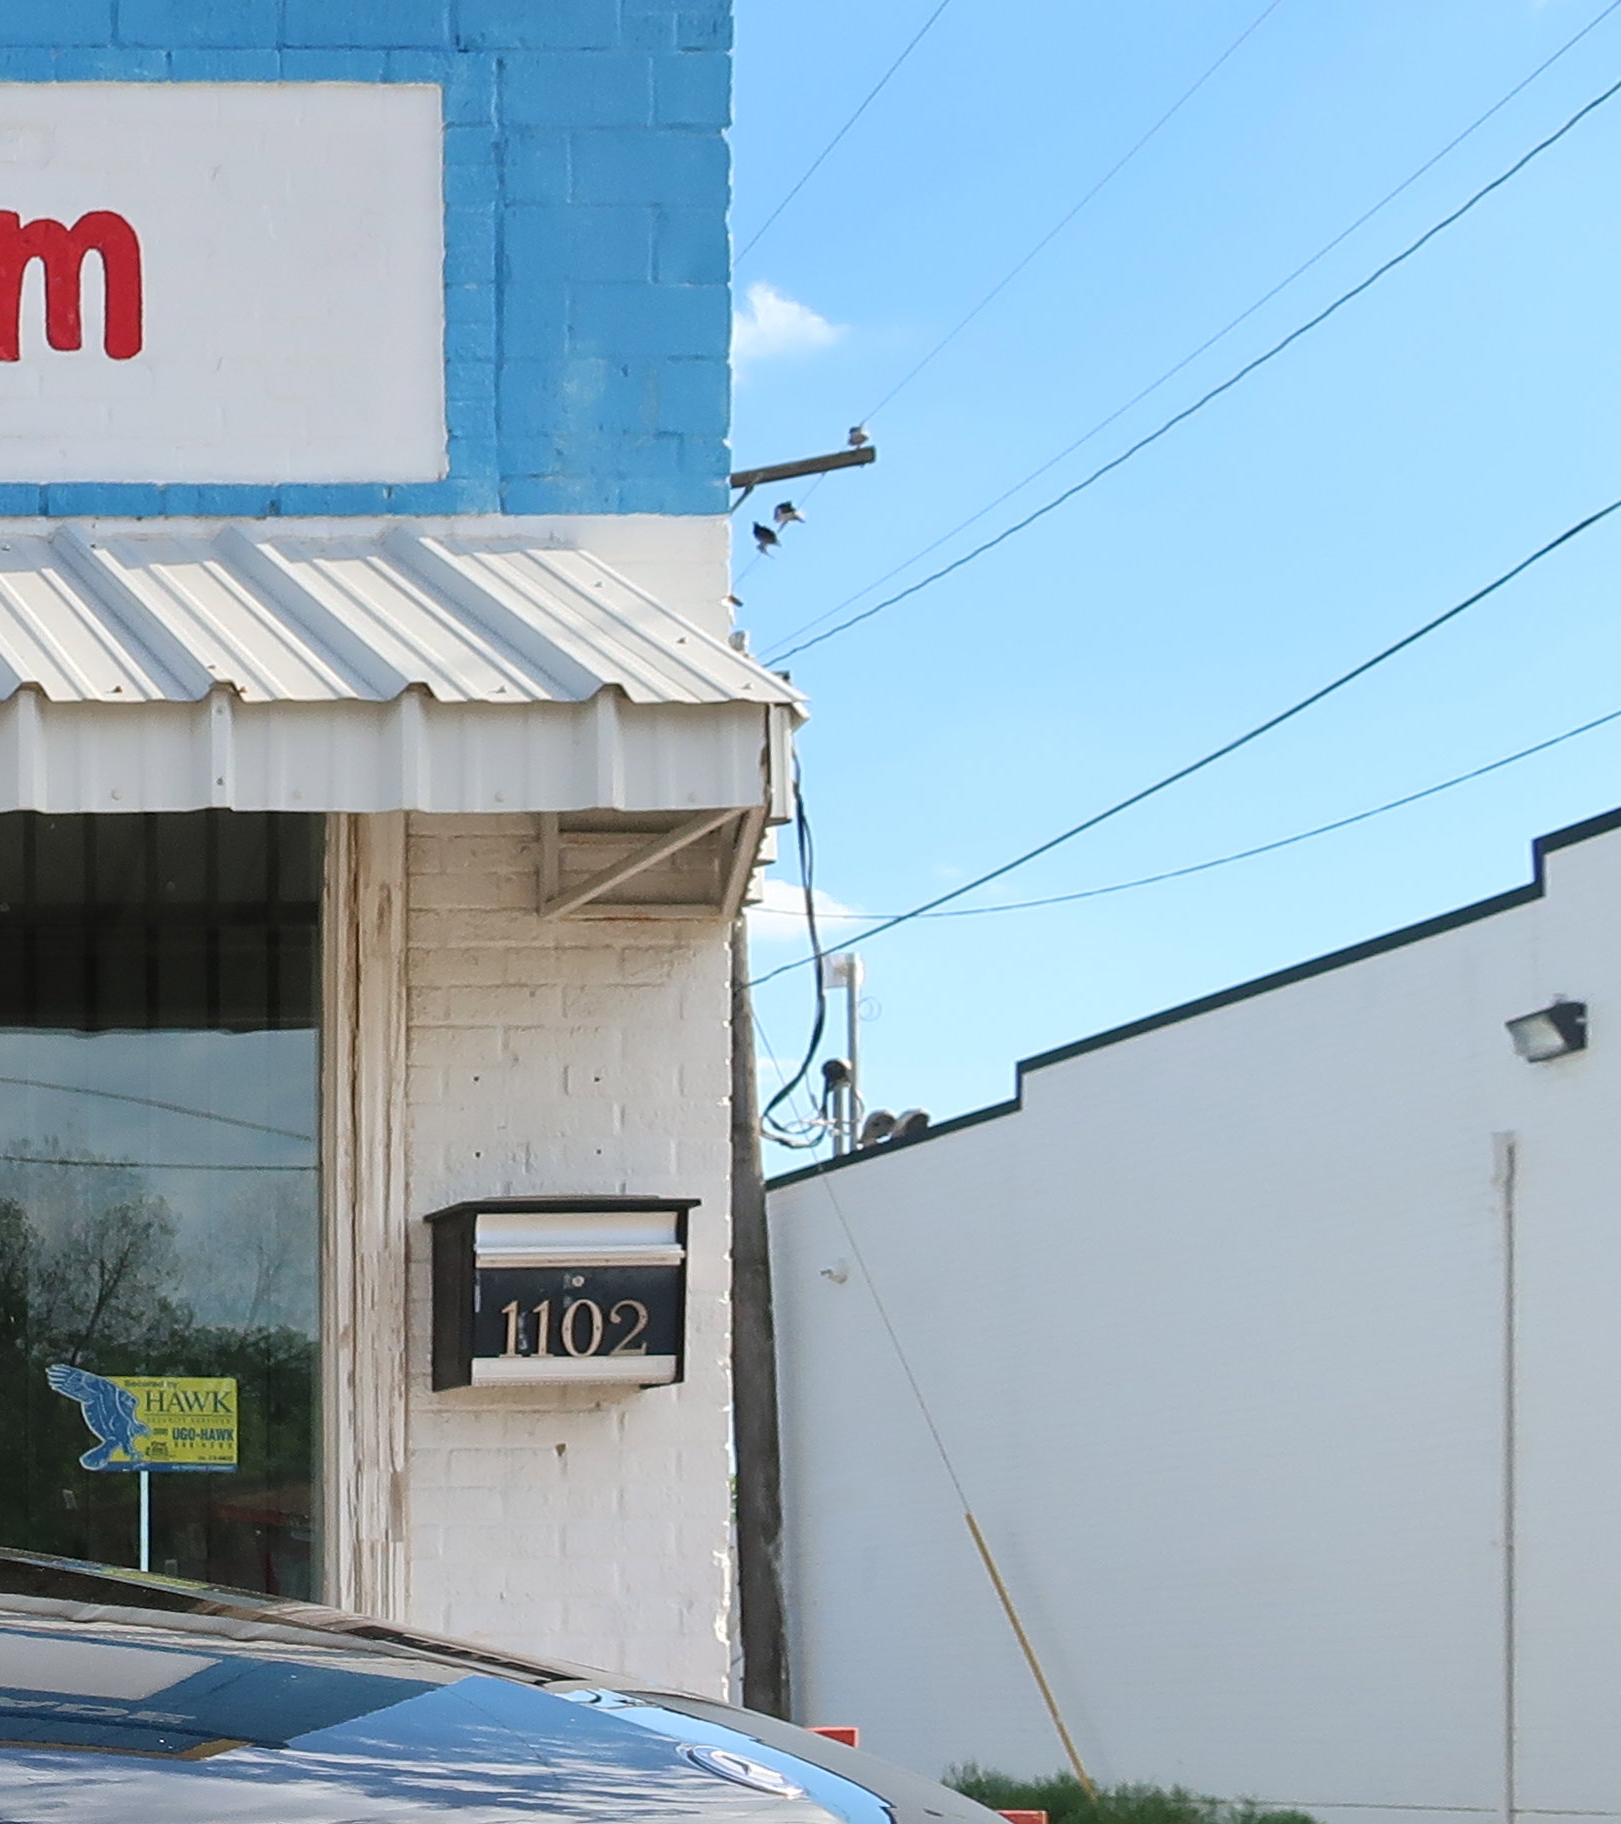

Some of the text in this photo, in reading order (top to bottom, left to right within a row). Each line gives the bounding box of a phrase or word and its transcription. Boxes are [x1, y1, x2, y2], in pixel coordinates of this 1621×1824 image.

[499, 1299, 649, 1358] 1102
[145, 1391, 233, 1413] HAWK
[173, 1428, 234, 1441] UGO-HAWK
